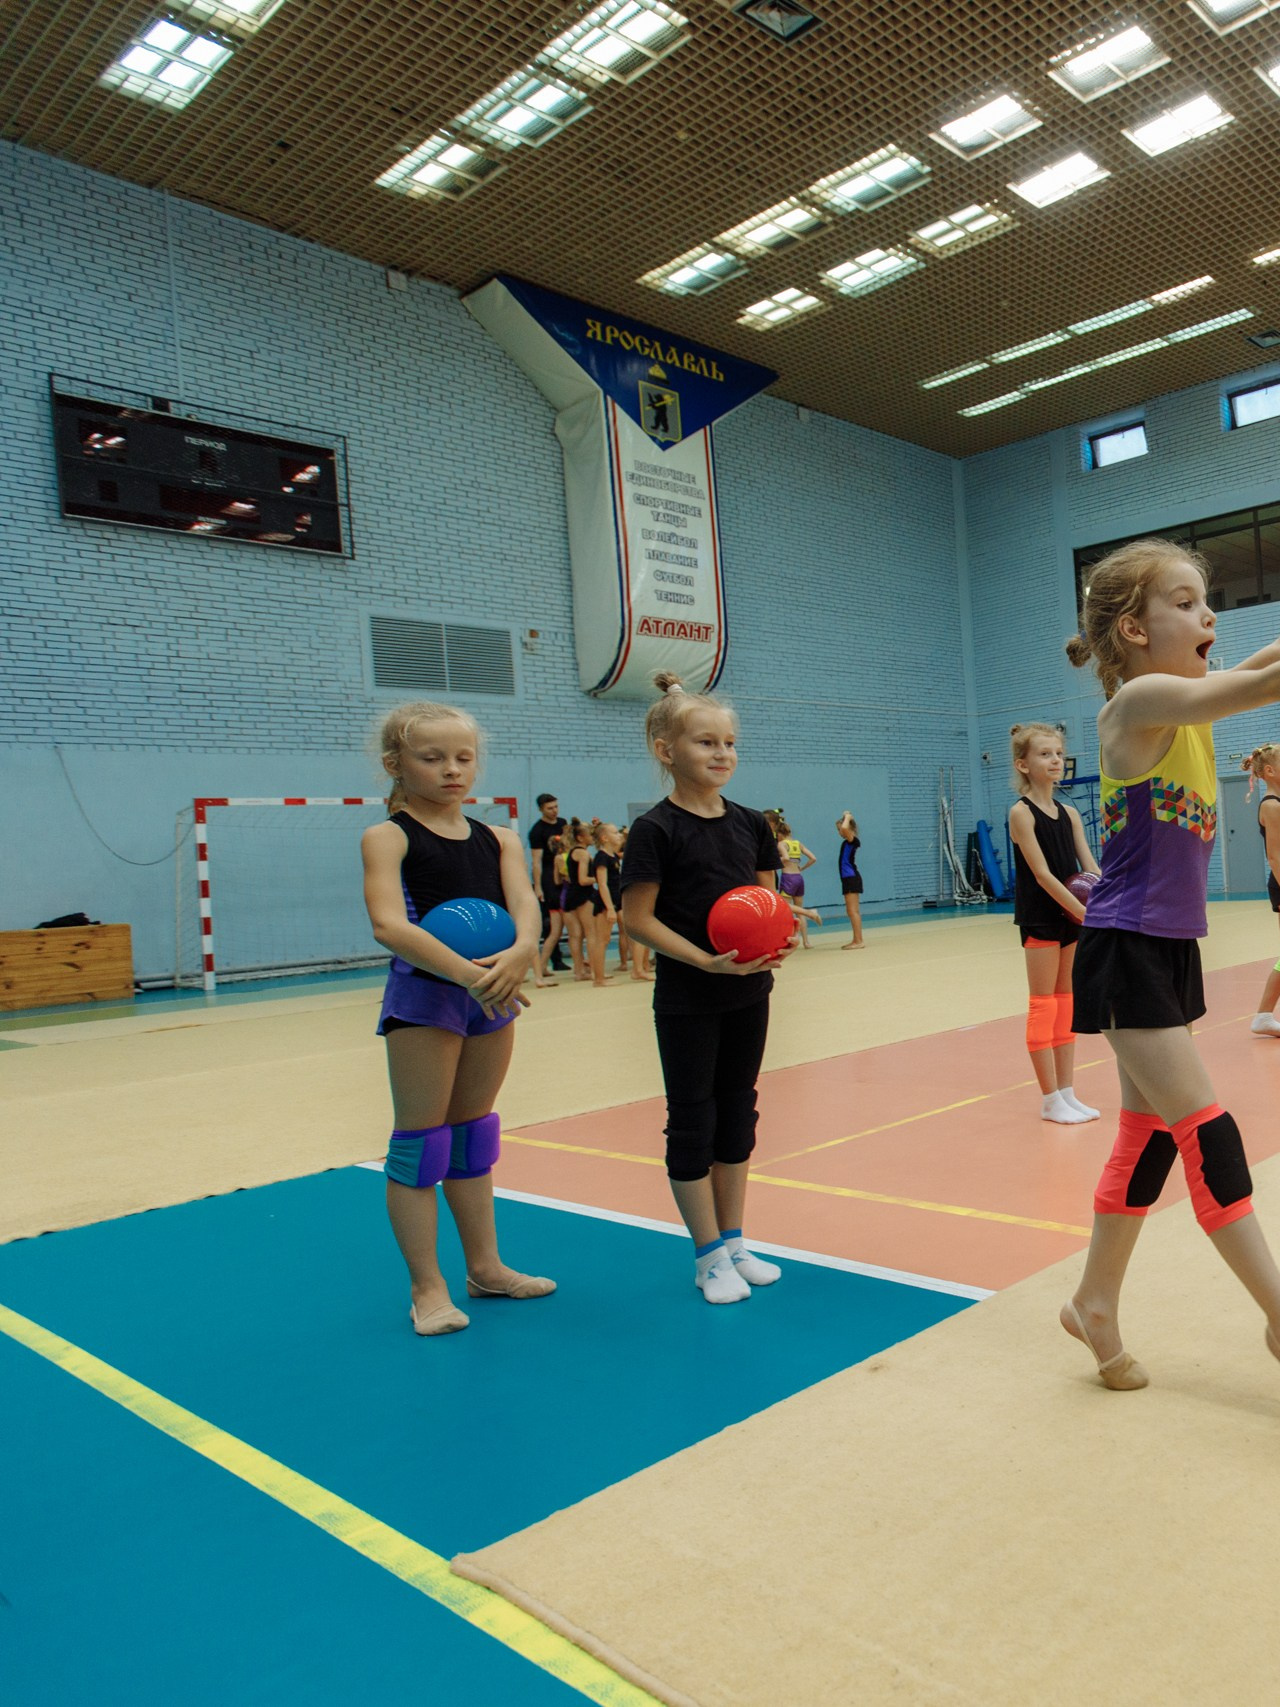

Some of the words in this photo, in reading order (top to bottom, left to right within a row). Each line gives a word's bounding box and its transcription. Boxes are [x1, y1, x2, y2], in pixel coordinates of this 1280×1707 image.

[586, 318, 725, 382] ЯРОСЛАВЛЬ
[634, 461, 696, 484] ВОСТОЧНЫЕ
[626, 472, 705, 500] ЕДИНОБОРСТВА
[633, 493, 703, 518] СПОРТИВНЫЕ
[650, 510, 688, 529] ТАНЦЫ
[641, 528, 698, 550] ВОЛЕЙБОЛ
[645, 548, 698, 568] ПЛАВАНИЕ
[654, 569, 695, 587] ФУТБОЛ
[655, 589, 695, 605] ТЕННИС
[637, 616, 713, 643] АТЛАНТ
